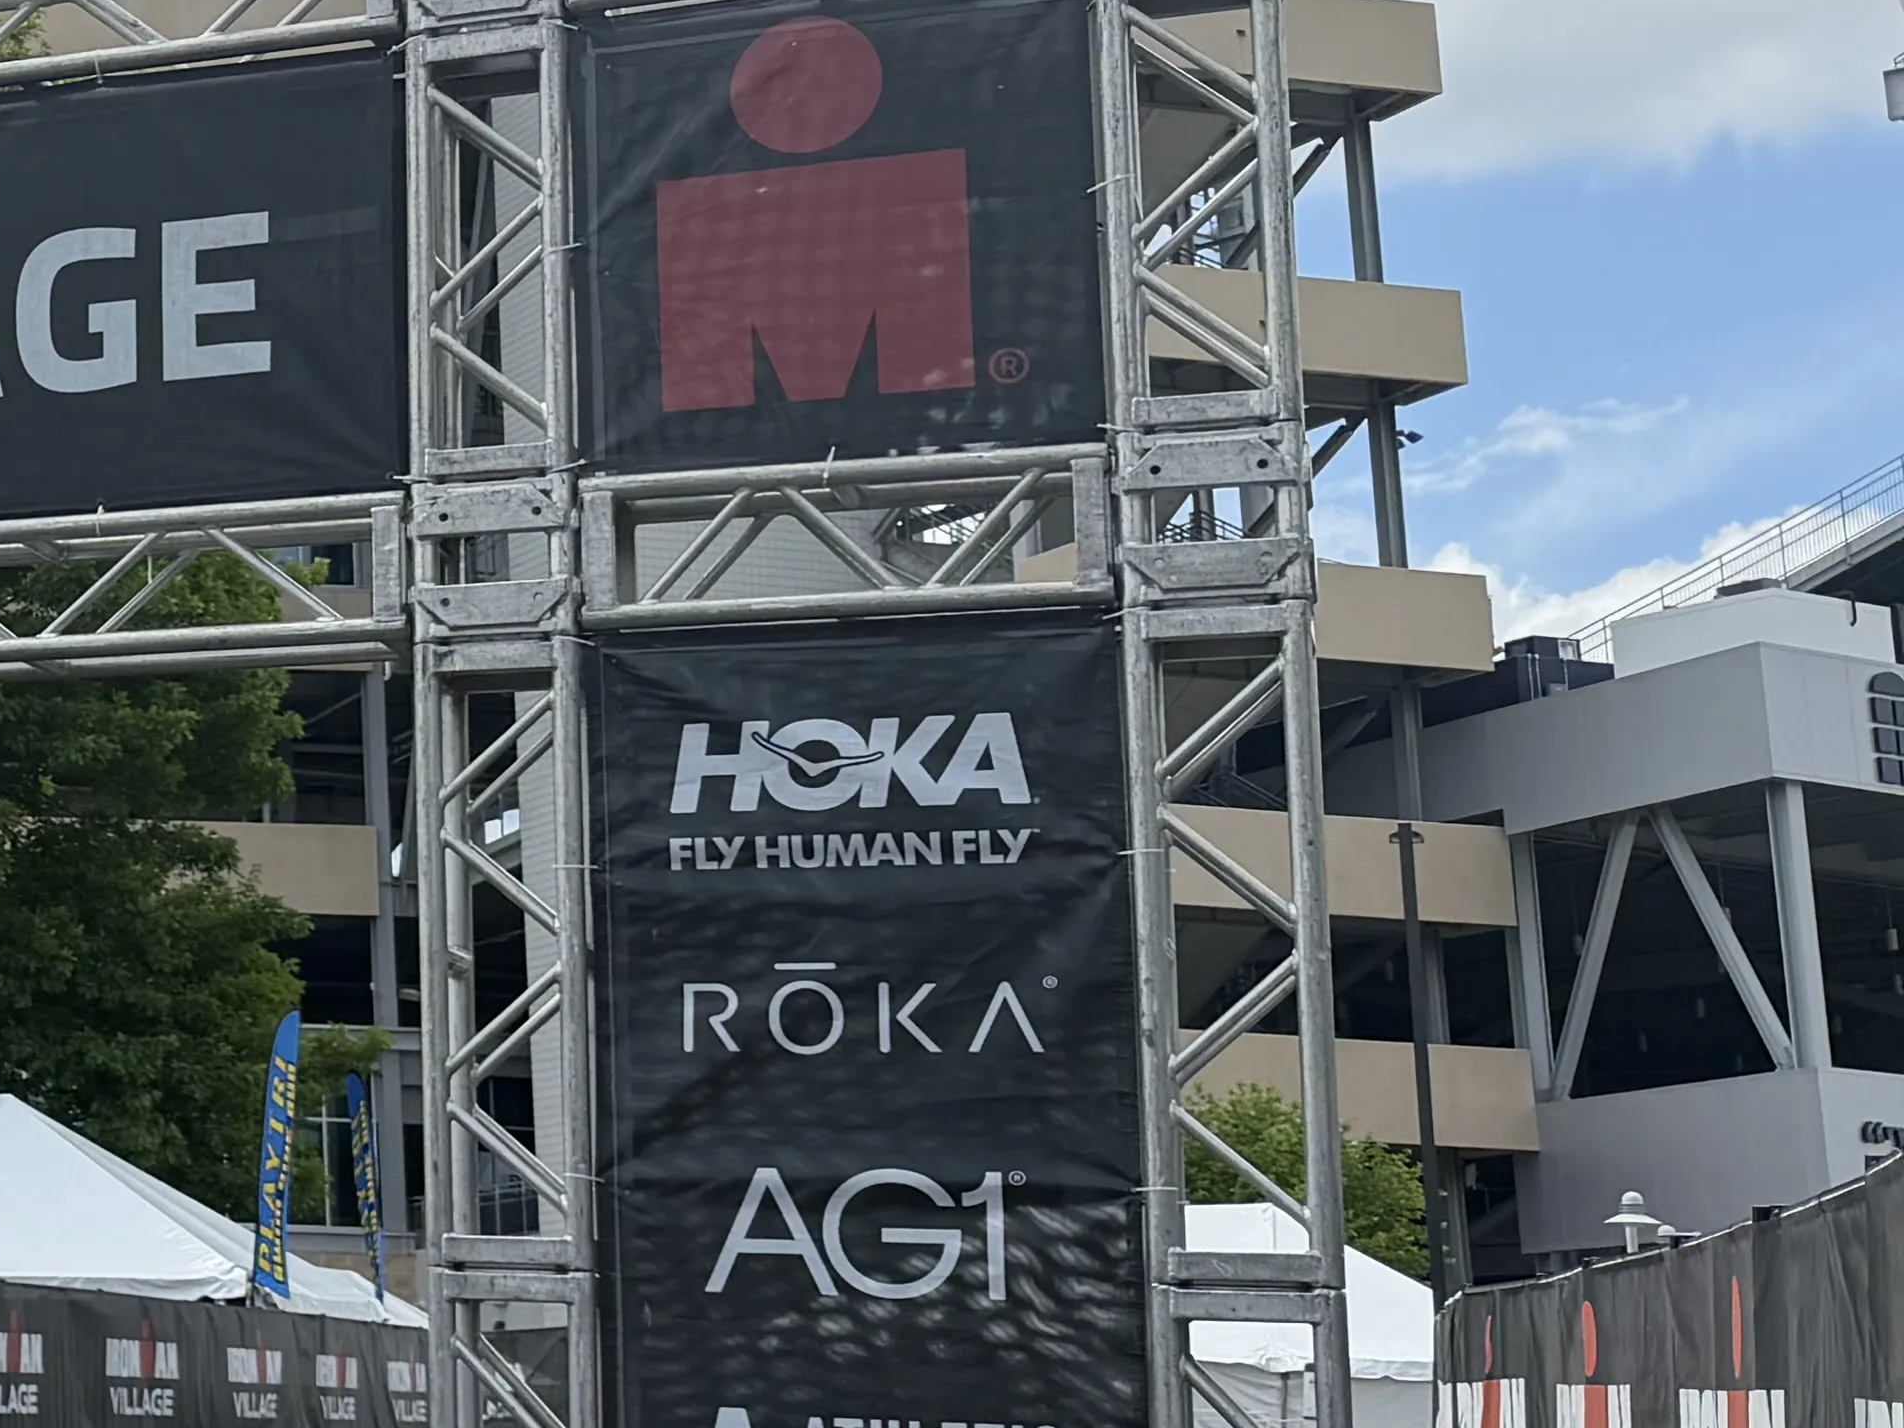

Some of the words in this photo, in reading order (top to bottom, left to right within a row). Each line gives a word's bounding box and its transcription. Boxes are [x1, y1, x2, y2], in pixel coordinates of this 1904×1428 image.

[669, 711, 1033, 814] HOKA
[669, 835, 745, 871] FLY
[755, 831, 944, 869] HUMAN
[952, 828, 1032, 865] FLY
[704, 1167, 1008, 1301] AG1
[109, 1386, 175, 1417] VILLAGE
